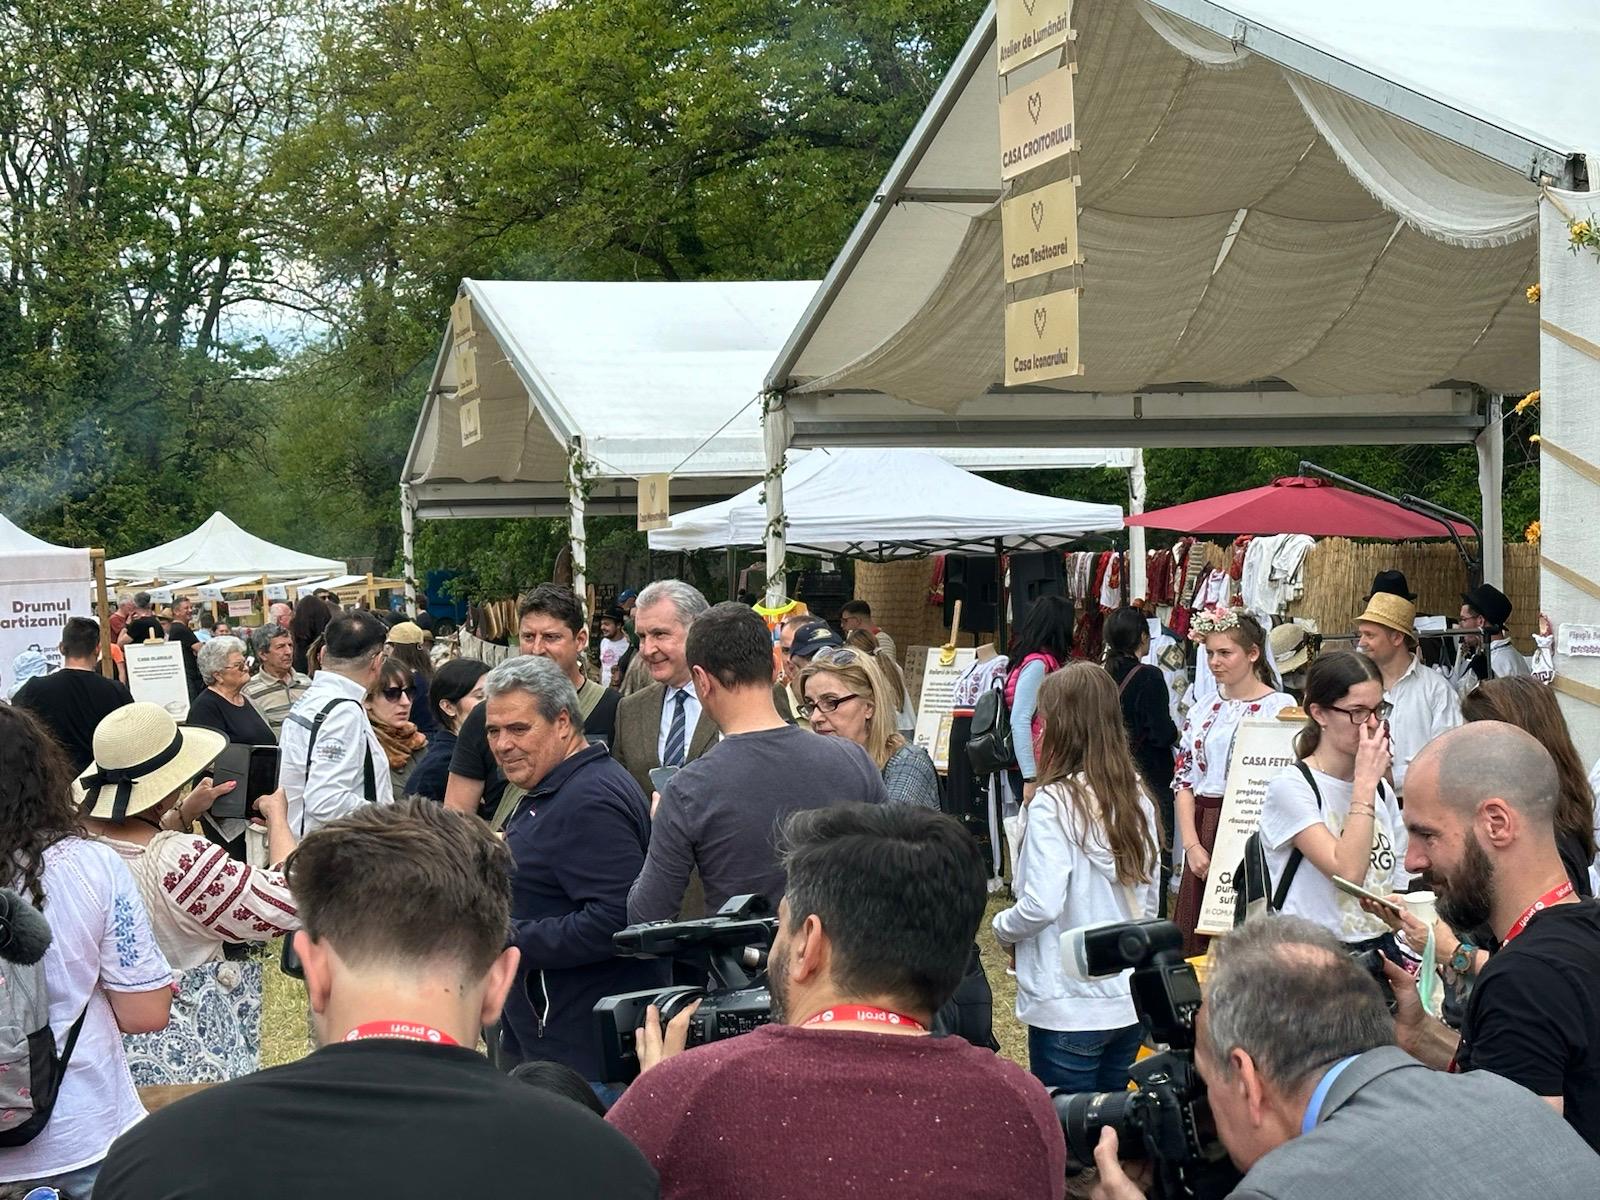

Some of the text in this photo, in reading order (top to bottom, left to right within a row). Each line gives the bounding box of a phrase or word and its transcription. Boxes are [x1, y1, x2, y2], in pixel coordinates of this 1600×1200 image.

[1000, 40, 1021, 62] Atelier
[1022, 33, 1032, 49] de
[1002, 123, 1072, 168] CASA CROITORULUI
[1011, 253, 1029, 269] Casa
[1014, 347, 1069, 373] Casa Iconarului
[12, 598, 71, 613] Drumul
[0, 613, 67, 629] artizanil
[1242, 756, 1296, 767] CASA FETEL
[1219, 895, 1237, 904] suf
[1518, 908, 1537, 928] profi
[856, 1010, 887, 1021] profi
[390, 1024, 425, 1035] profi
